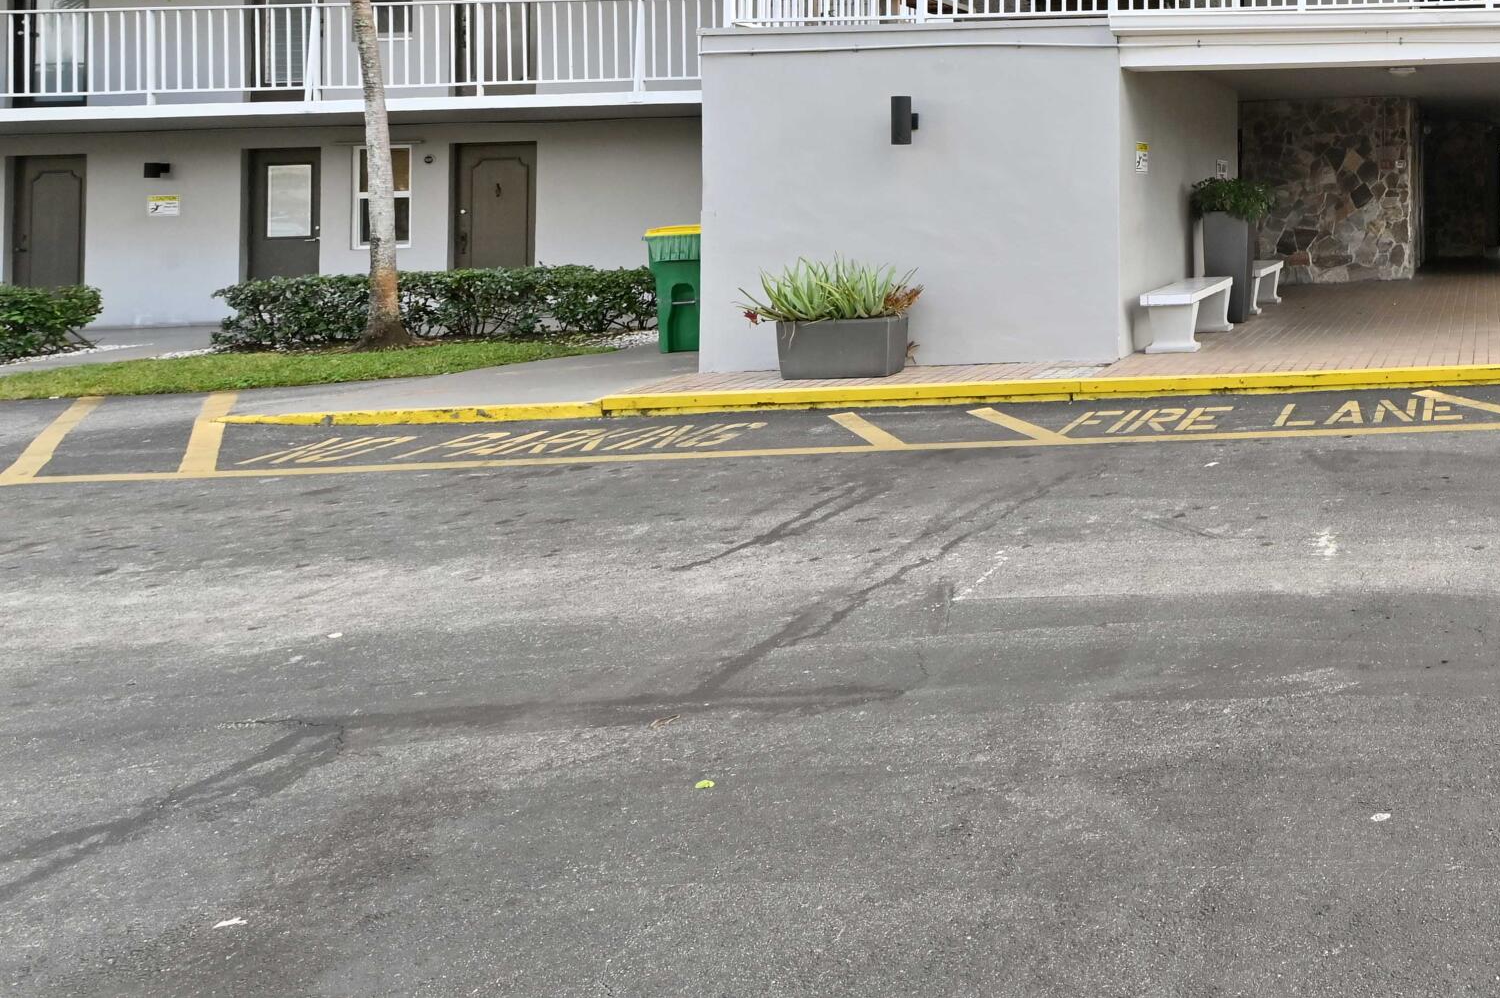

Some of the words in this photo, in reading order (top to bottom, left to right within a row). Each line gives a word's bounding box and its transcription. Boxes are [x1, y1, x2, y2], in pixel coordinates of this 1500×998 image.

[1057, 406, 1234, 435] FIRE
[1273, 397, 1464, 427] LANE
[235, 436, 419, 465] NO
[392, 422, 768, 460] PARKING
